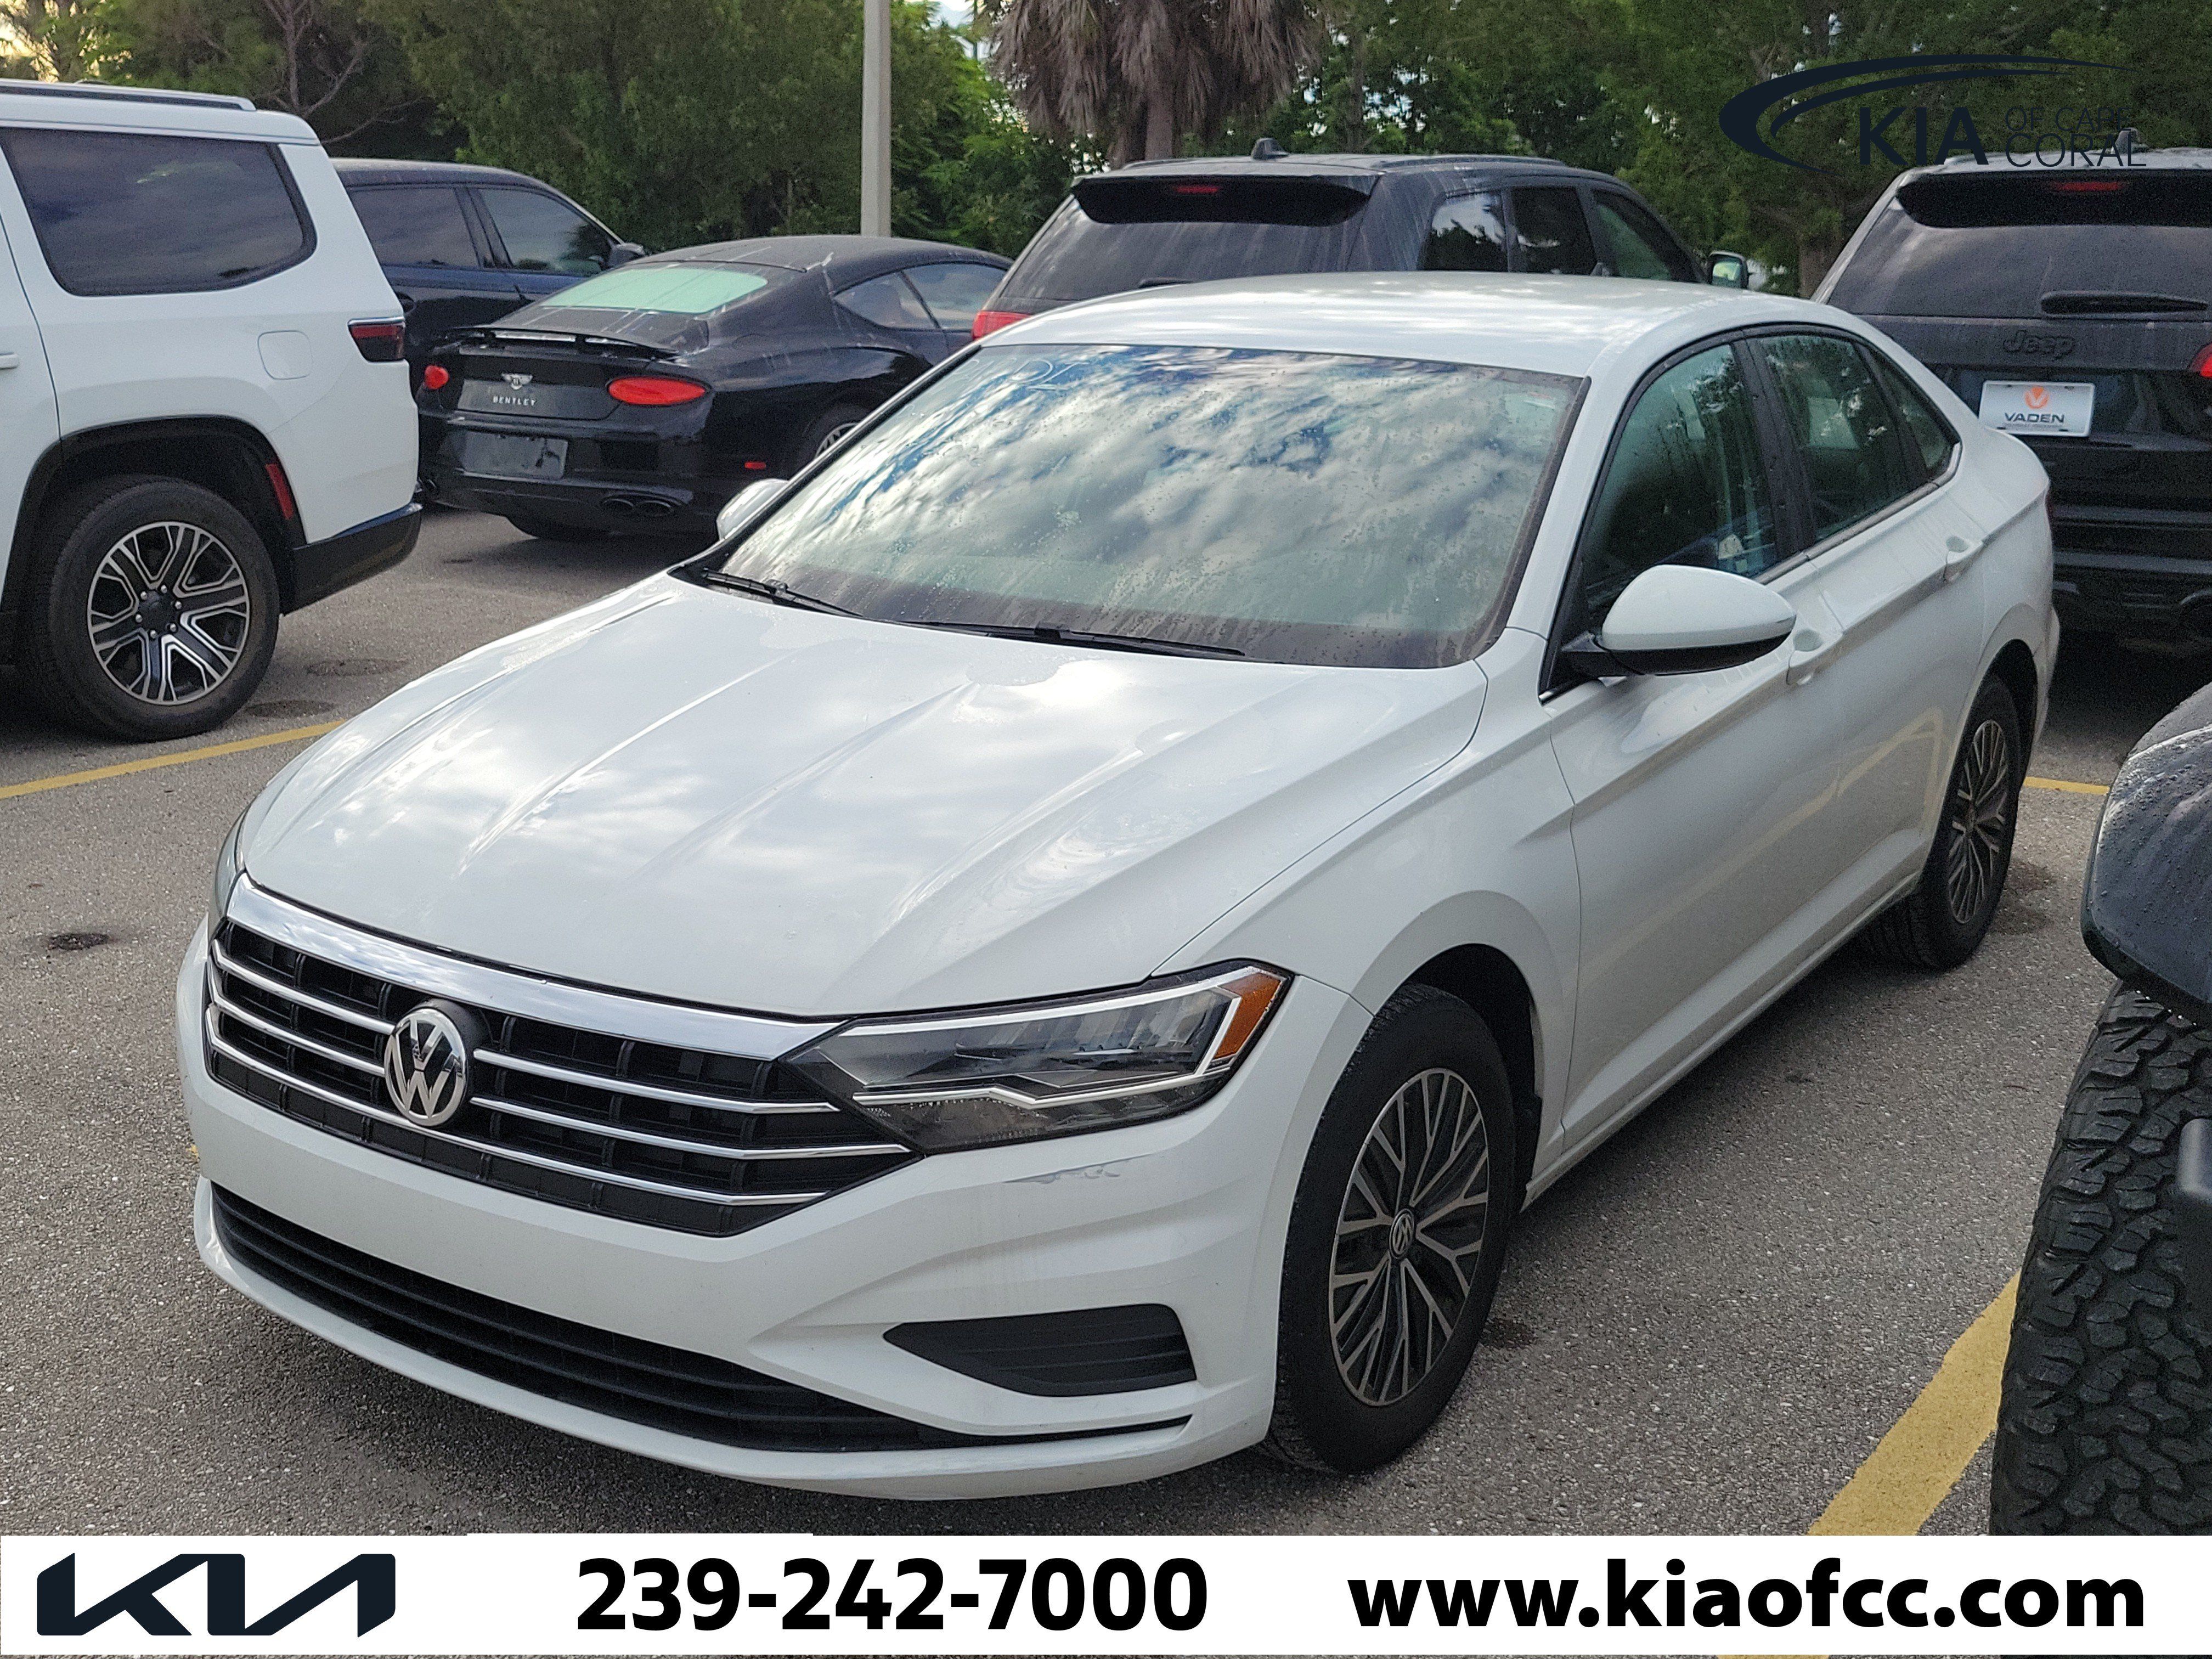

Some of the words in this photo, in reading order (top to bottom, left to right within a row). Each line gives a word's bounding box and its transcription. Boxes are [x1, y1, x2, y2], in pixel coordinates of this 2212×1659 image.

[2003, 329, 2075, 359] Jeep
[493, 396, 537, 407] BENTLEY
[2004, 412, 2065, 423] VADEN
